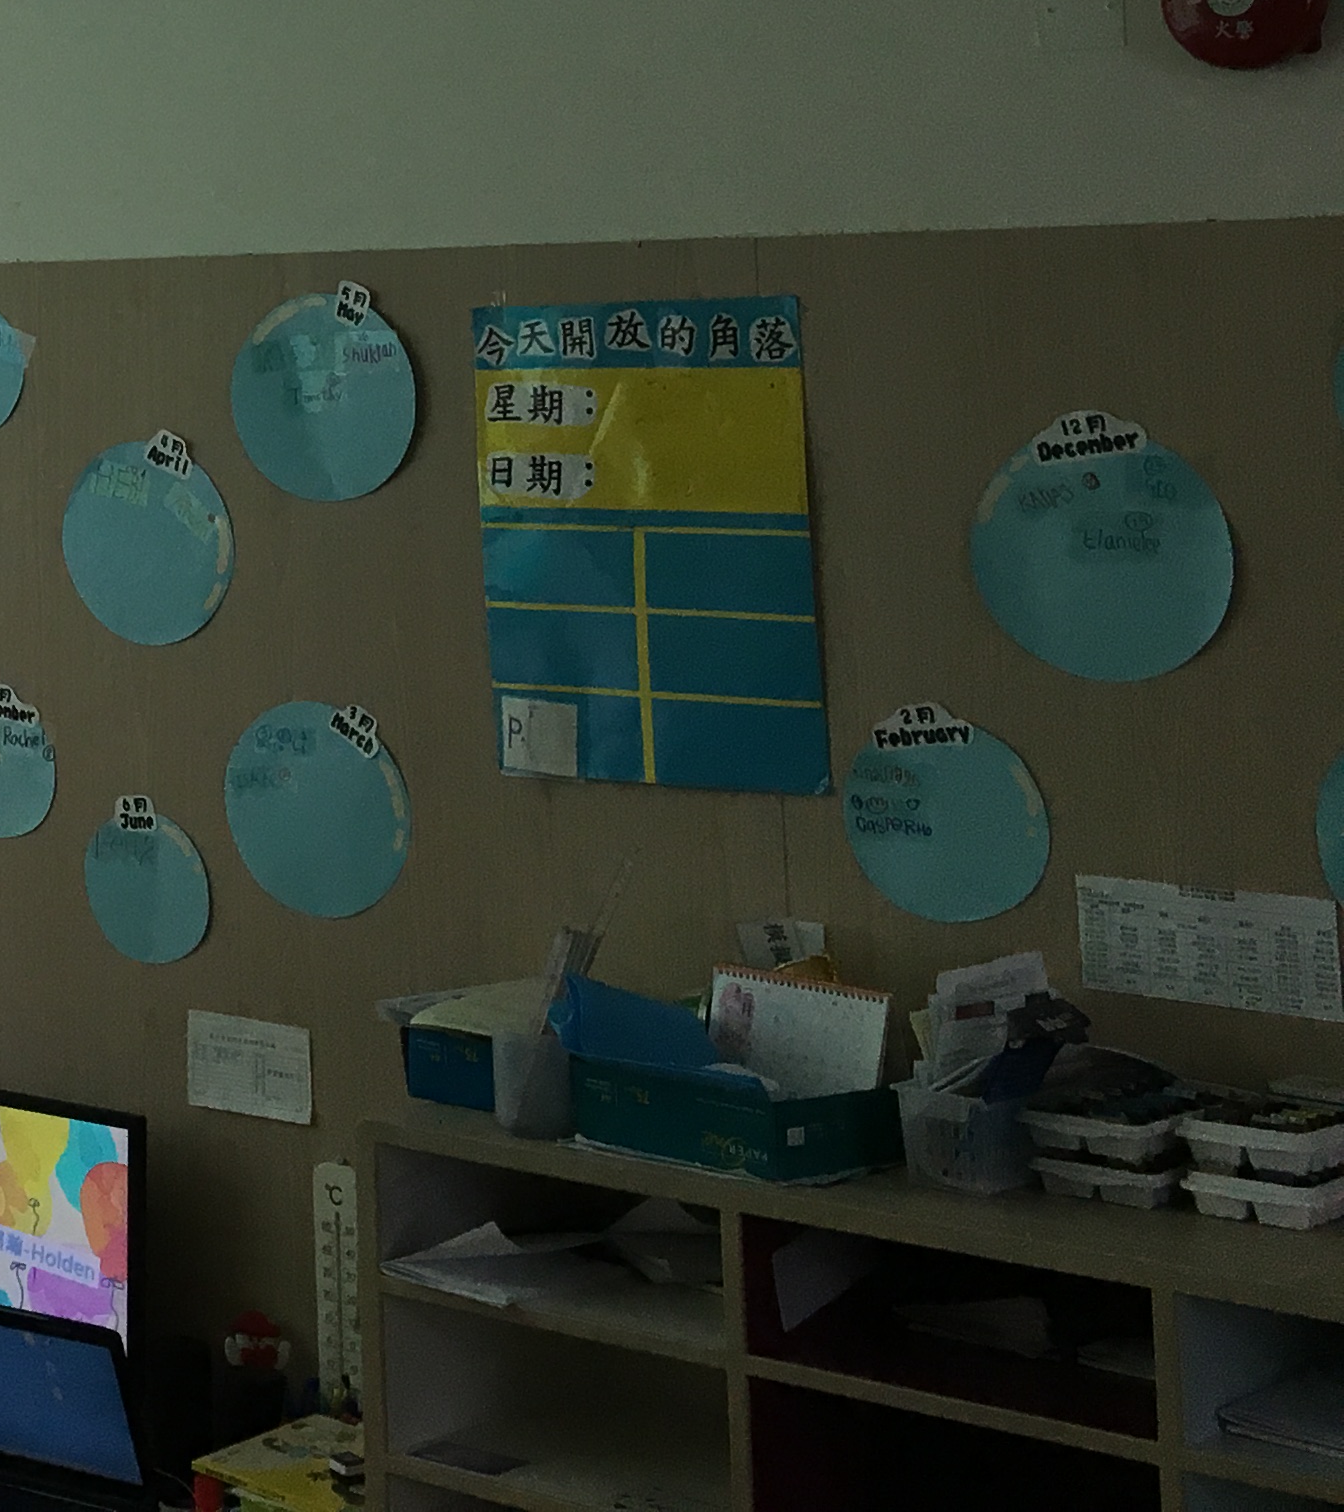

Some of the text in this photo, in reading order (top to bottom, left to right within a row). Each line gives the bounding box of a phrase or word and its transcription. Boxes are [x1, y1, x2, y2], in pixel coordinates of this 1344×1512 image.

[336, 300, 365, 327] May
[476, 309, 799, 366] 今天開放的角落
[146, 445, 189, 476] April
[1037, 431, 1140, 463] December
[330, 712, 374, 755] March
[873, 725, 970, 749] February
[119, 812, 155, 830] June
